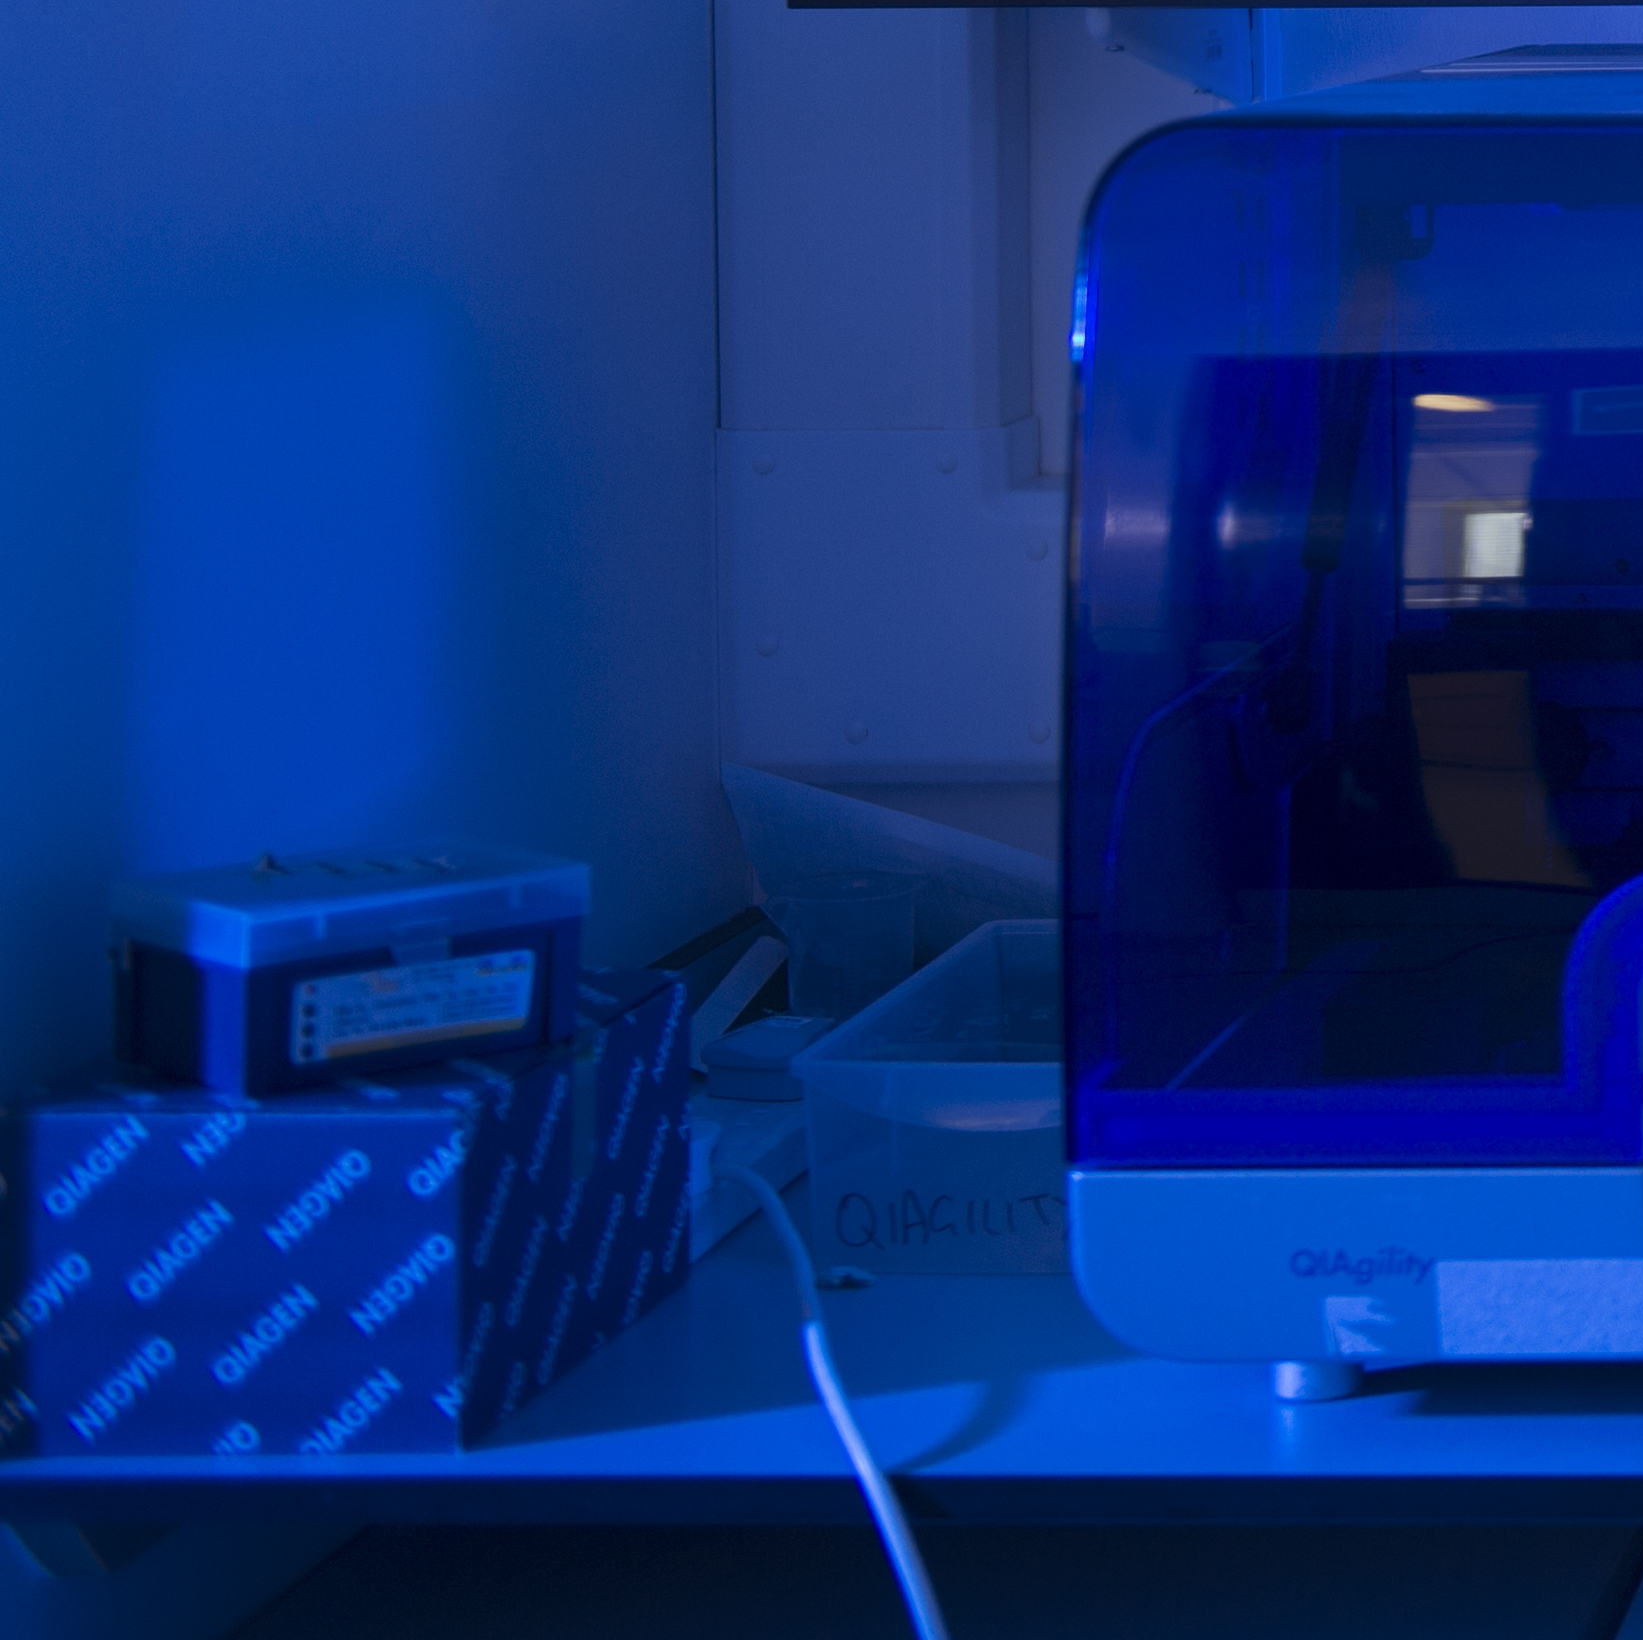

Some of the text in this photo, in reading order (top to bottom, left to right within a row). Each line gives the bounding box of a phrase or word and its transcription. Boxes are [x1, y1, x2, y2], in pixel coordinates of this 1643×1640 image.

[43, 1113, 150, 1217] QIAGEN
[264, 1147, 372, 1253] QIAGEN
[126, 1198, 235, 1303] QIAGEN
[836, 1189, 1068, 1252] QIAGILIT
[211, 1282, 319, 1387] QIAGEN
[350, 1233, 456, 1337] QIAGEN
